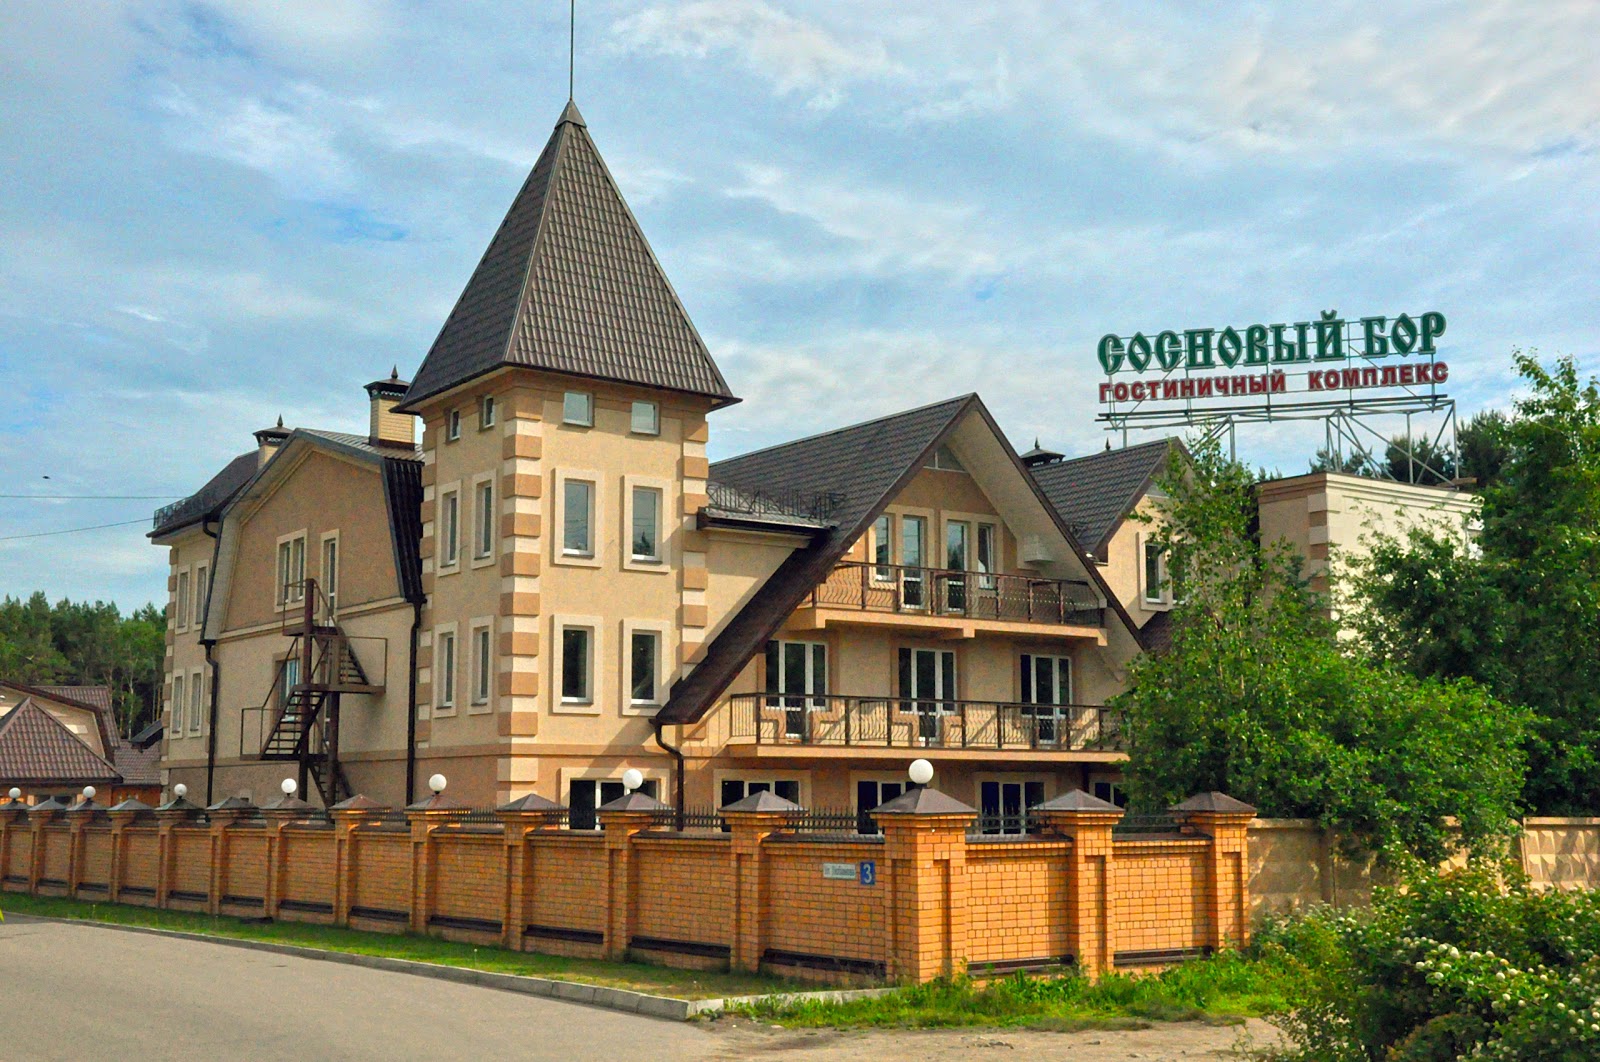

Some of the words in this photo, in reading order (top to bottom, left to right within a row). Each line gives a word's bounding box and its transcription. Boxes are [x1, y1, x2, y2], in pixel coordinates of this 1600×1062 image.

[1098, 310, 1346, 374] СОСНОВЫЙ
[1360, 311, 1446, 358] БОР
[1099, 369, 1287, 403] ГОСТИНИЧНЫЙ
[1308, 361, 1449, 391] КОМПЛЕКС
[863, 863, 872, 883] 3
